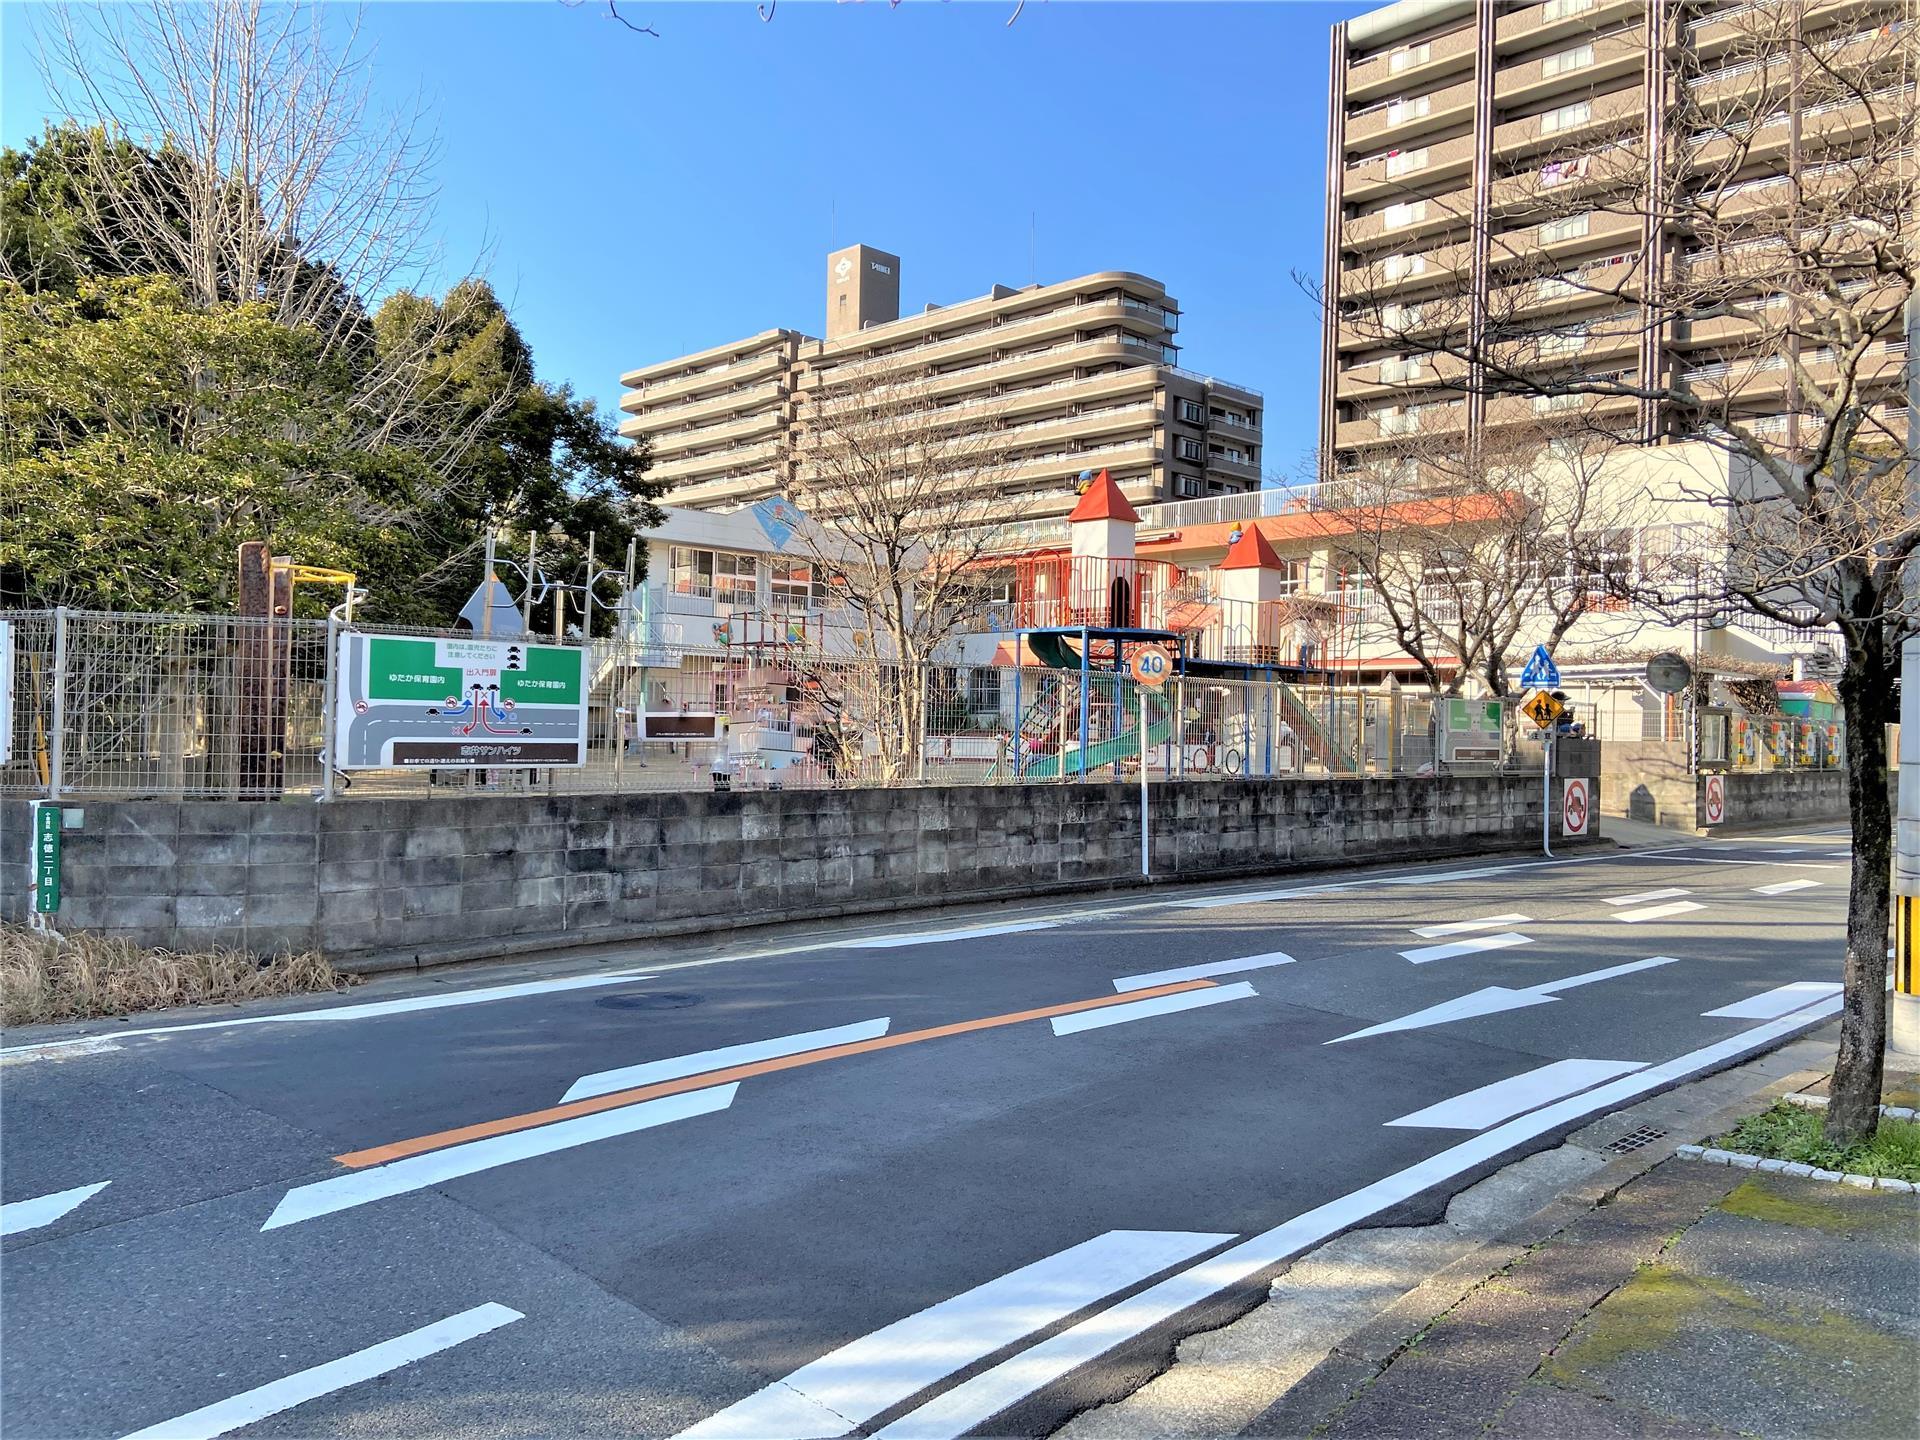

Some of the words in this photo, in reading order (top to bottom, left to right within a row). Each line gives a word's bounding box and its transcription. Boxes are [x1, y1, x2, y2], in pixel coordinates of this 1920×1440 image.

[1141, 656, 1162, 673] 40
[389, 674, 445, 684] ゆたか保育園内
[43, 833, 53, 886] 志徳二丁目
